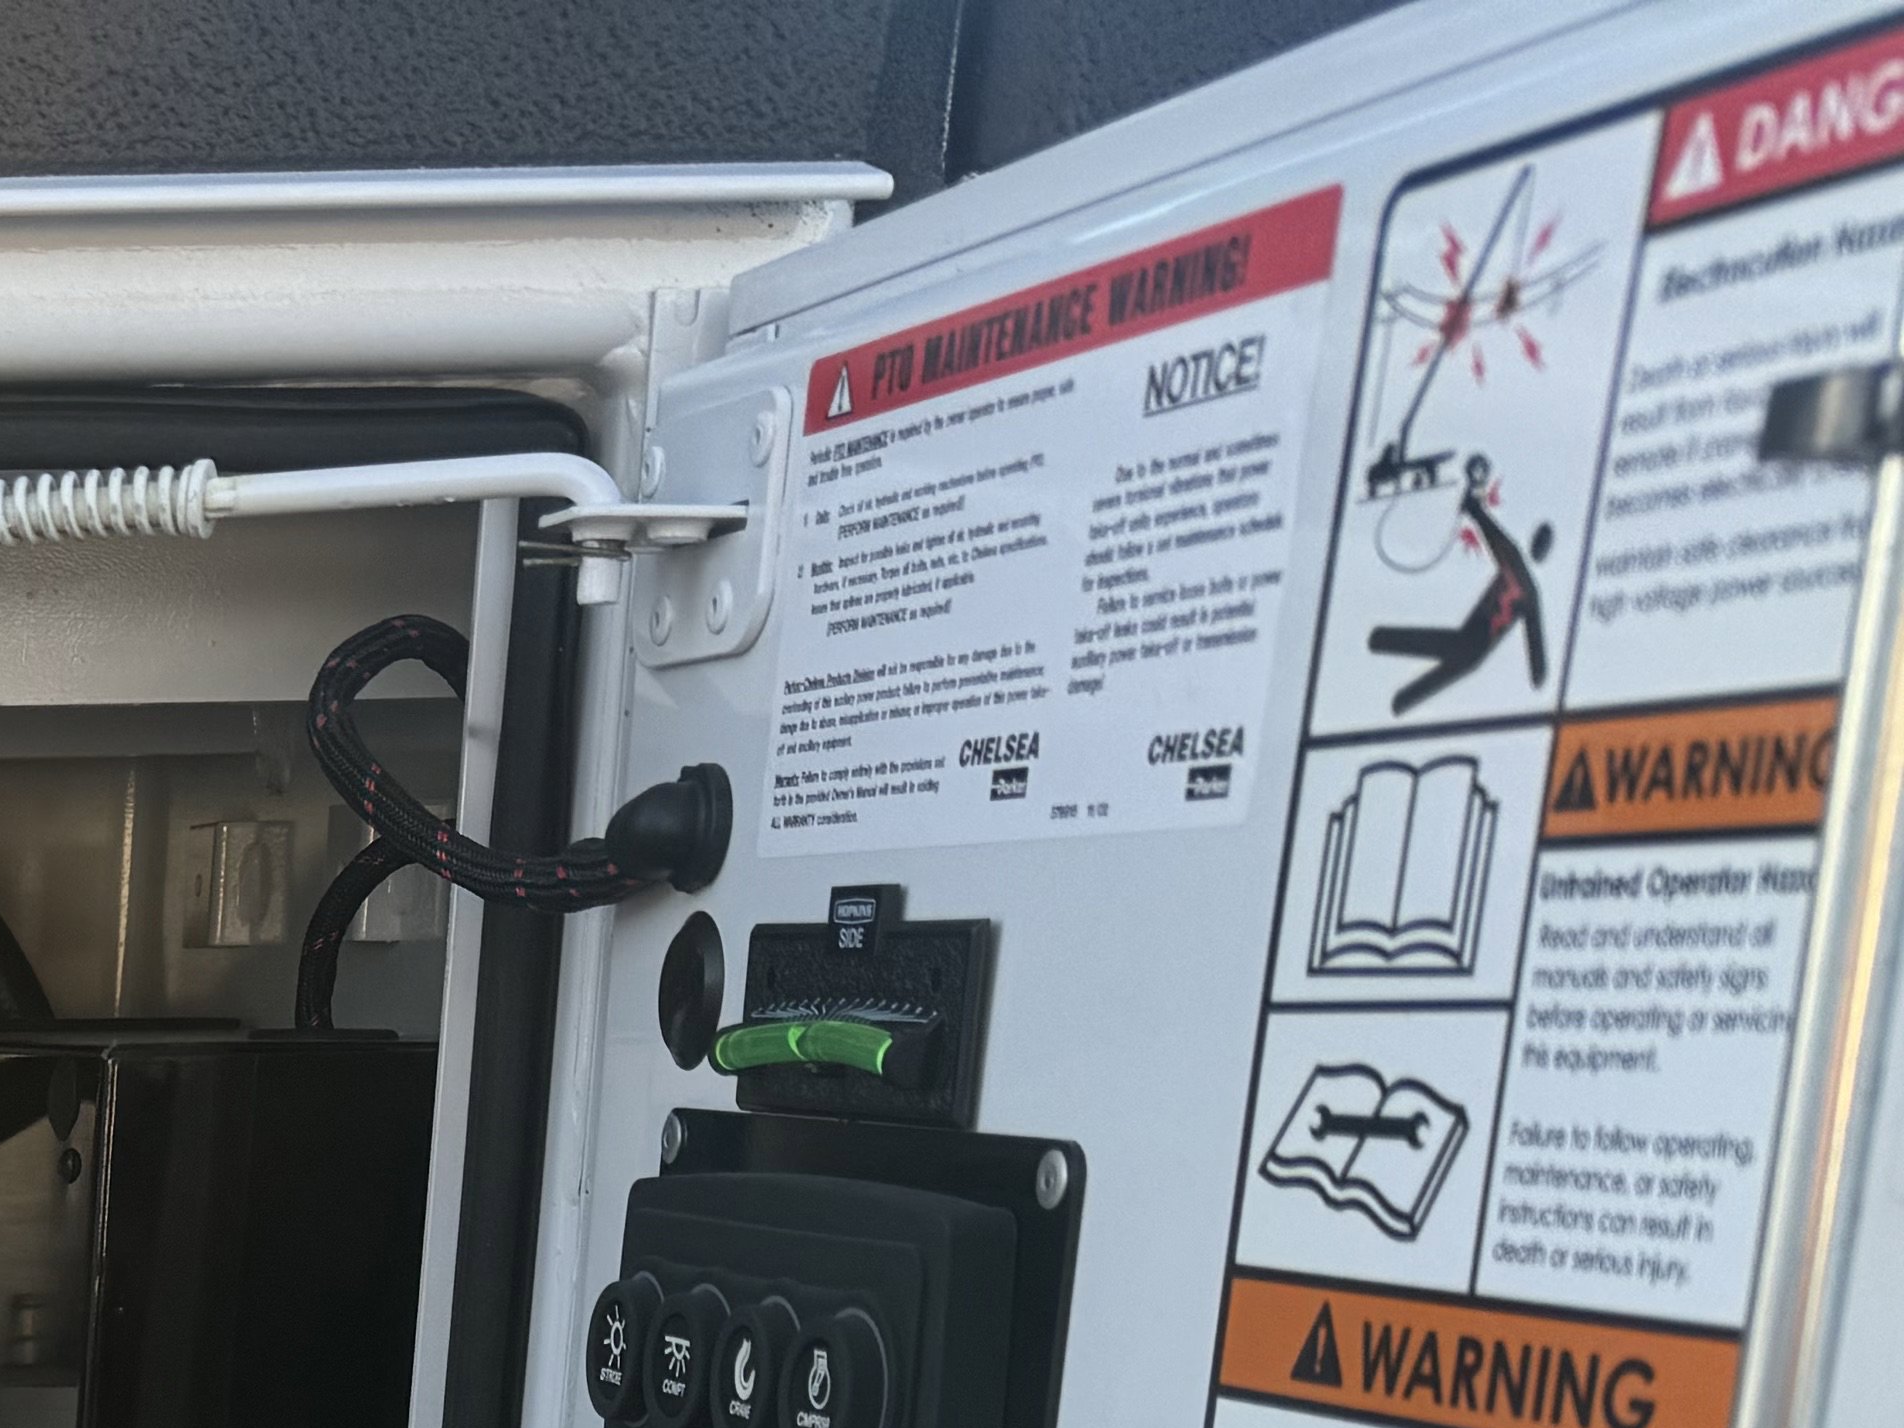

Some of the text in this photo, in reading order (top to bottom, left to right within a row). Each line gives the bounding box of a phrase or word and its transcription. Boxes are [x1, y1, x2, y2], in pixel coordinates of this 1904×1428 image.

[872, 232, 1252, 401] PTO MAINTENANCE WARNING!
[1145, 335, 1266, 403] NOTICE!
[959, 731, 1040, 768] CHELSEA
[1147, 726, 1244, 766] CHELSEA
[1646, 864, 1751, 904] Operator
[839, 927, 864, 949] SIDE
[1538, 922, 1589, 950] Read
[1590, 924, 1631, 950] and
